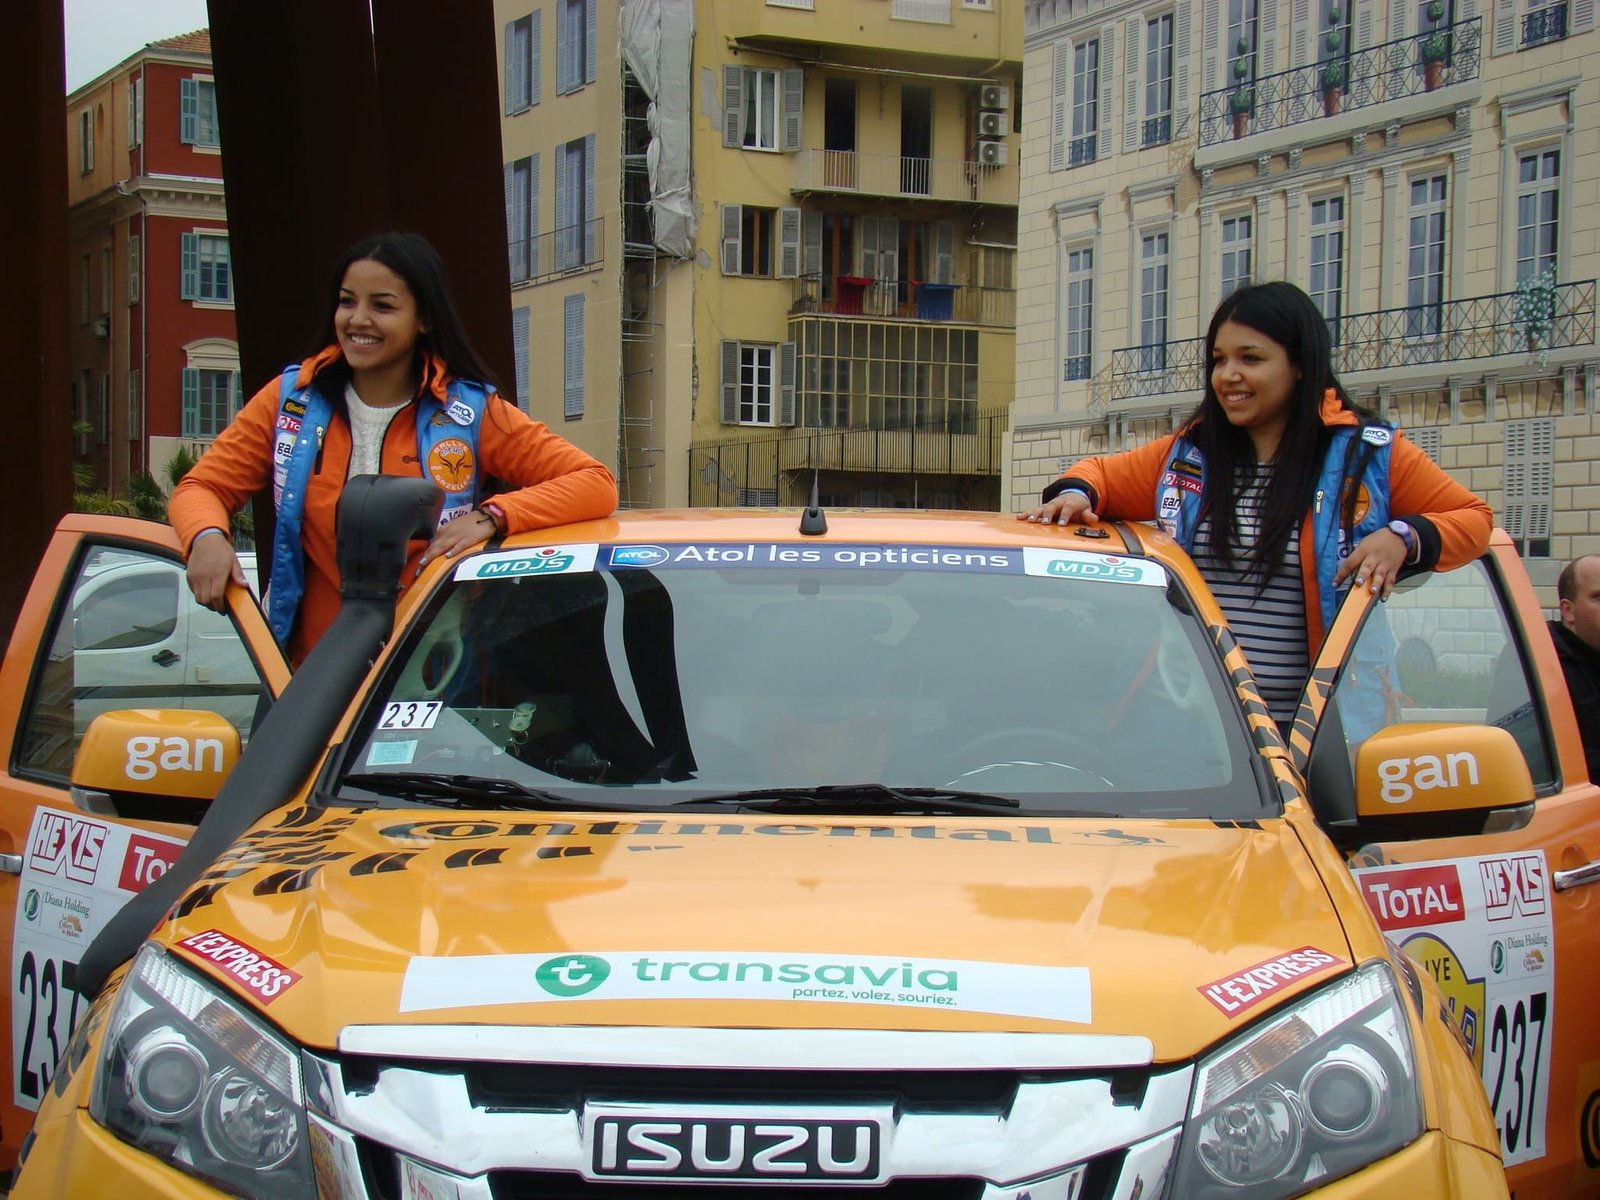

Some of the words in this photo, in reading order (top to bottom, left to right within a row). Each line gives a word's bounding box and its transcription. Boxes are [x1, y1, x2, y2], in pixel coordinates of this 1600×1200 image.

[452, 404, 472, 419] ATOL
[485, 555, 565, 575] MDJS
[674, 545, 754, 562] Atol
[770, 545, 820, 562] les
[834, 548, 1009, 567] opticiens
[1054, 561, 1136, 578] MDJS
[382, 702, 438, 728] 237
[126, 736, 224, 781] gan
[1378, 752, 1479, 804] gan
[30, 812, 107, 885] HEXIS
[379, 819, 1062, 847] Continental
[45, 892, 63, 907] Diana
[64, 897, 90, 919] Holding
[1369, 883, 1458, 919] TOTAL
[1479, 856, 1545, 921] HEXIS
[1508, 936, 1524, 949] Diana
[1525, 932, 1548, 947] Holding
[183, 931, 292, 996] L'EXPRESS
[632, 957, 958, 991] transavia
[1206, 949, 1334, 1012] L'EXPRESS
[793, 988, 848, 999] partez,
[851, 990, 894, 1002] volez,
[897, 993, 957, 1005] souriez.
[1491, 992, 1547, 1154] 237
[601, 1122, 871, 1174] ISUZU
